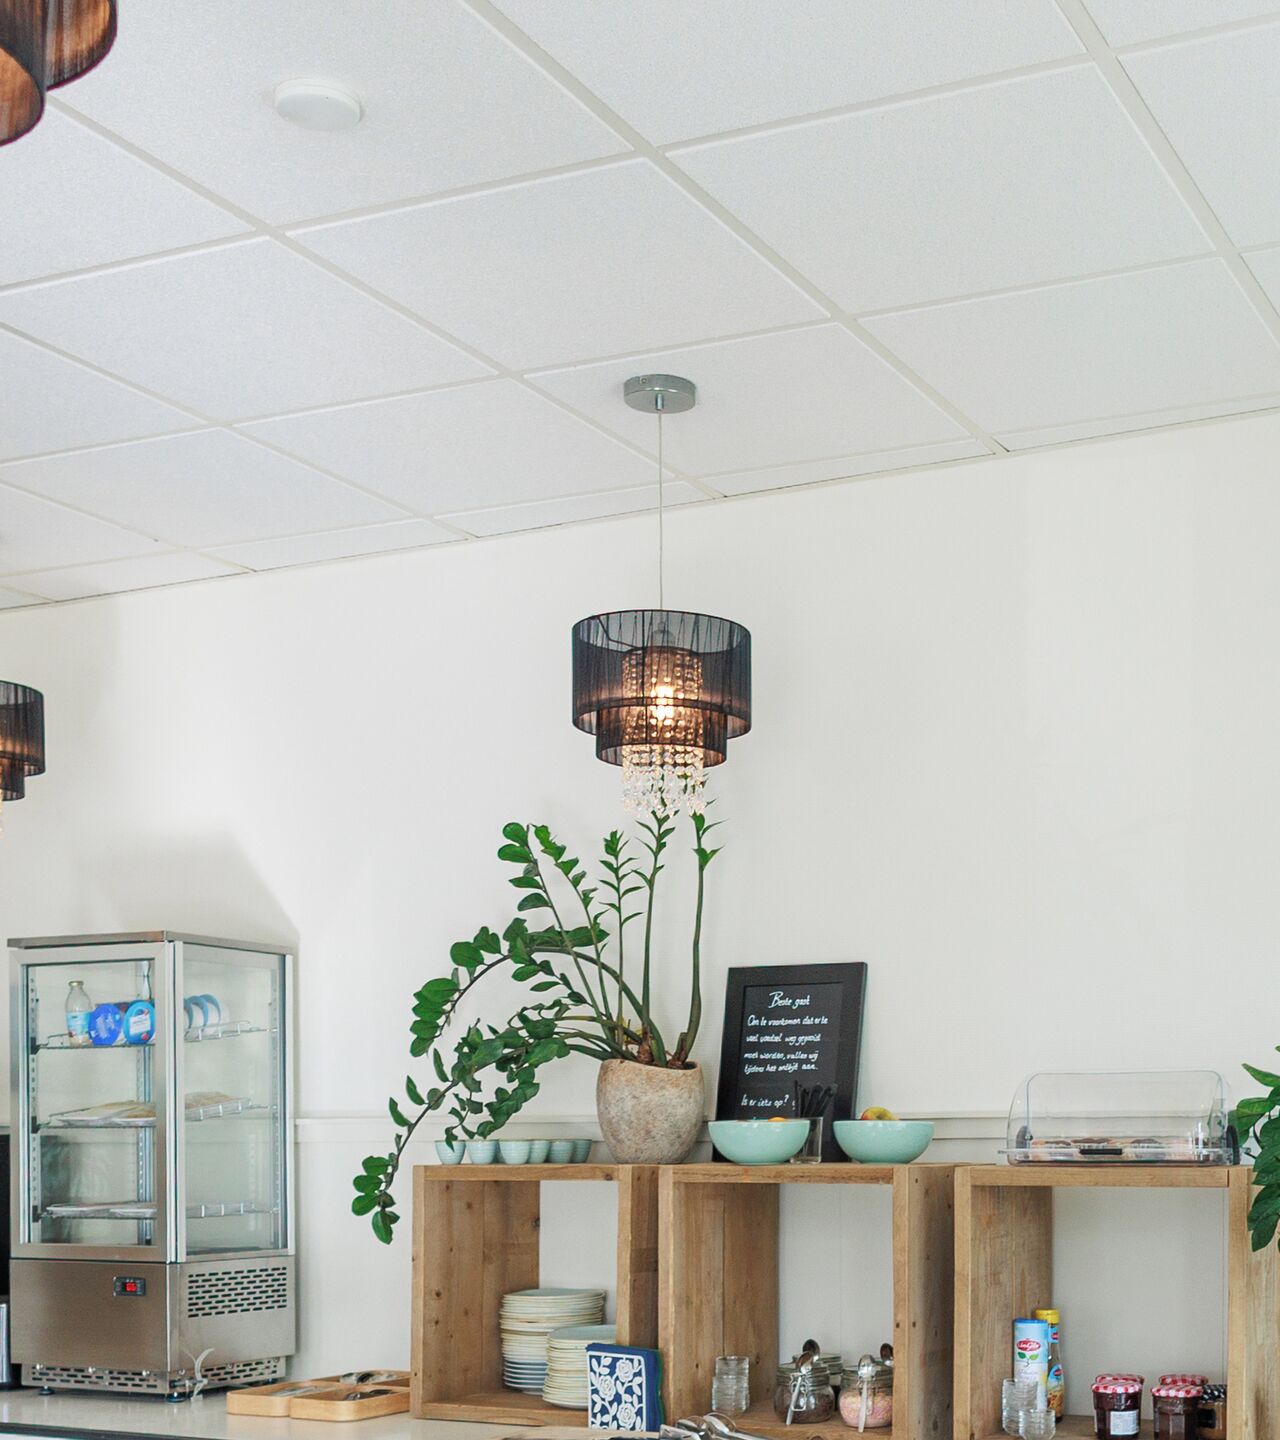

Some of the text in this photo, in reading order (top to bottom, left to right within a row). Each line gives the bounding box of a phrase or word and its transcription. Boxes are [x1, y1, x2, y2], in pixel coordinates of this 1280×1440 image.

[768, 991, 810, 1009] Beste gast
[748, 1015, 759, 1026] Om
[760, 1016, 767, 1026] te
[768, 1018, 801, 1026] voorkomen
[802, 1016, 814, 1025] dat
[741, 1094, 748, 1106] Is
[774, 1094, 790, 1109] op?
